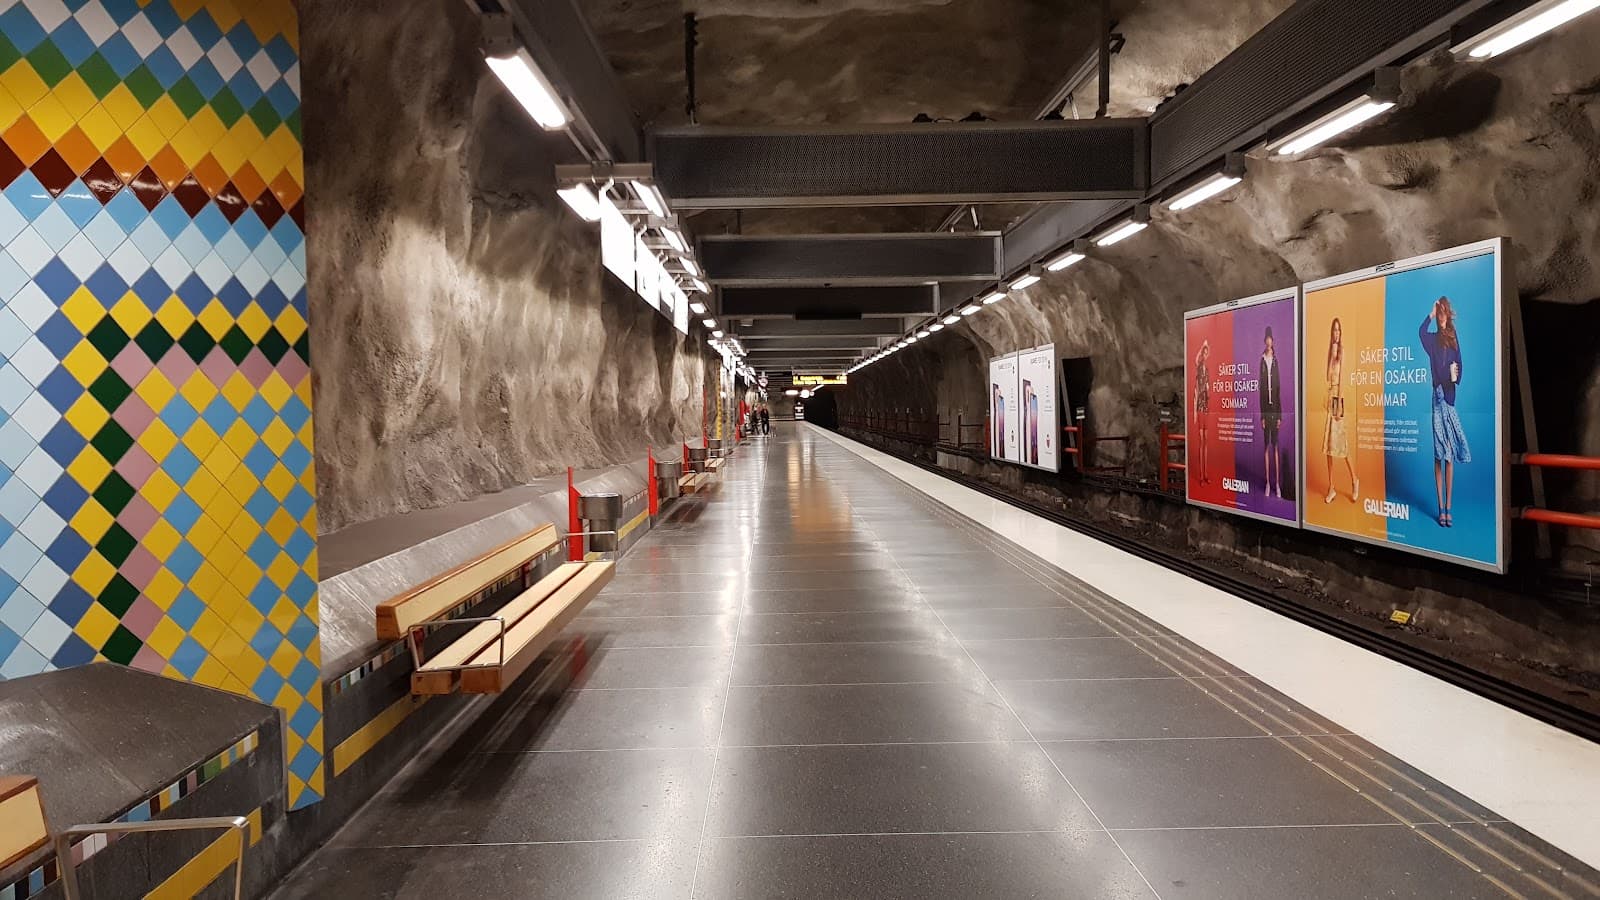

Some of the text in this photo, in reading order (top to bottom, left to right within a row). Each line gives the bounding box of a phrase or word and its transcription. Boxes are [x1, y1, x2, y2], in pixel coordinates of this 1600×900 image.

[1360, 346, 1415, 364] SÄKER STIL
[1218, 362, 1251, 376] SÄKER STIL
[1350, 366, 1428, 386] FÖR EN OSÄKER
[1212, 378, 1259, 392] FÖR EN OSÄKER
[1221, 397, 1248, 409] SOMMAR
[1364, 391, 1408, 407] SOMMAR
[1222, 477, 1250, 494] GALLERIAN
[1363, 497, 1410, 521] GALLERIAN
